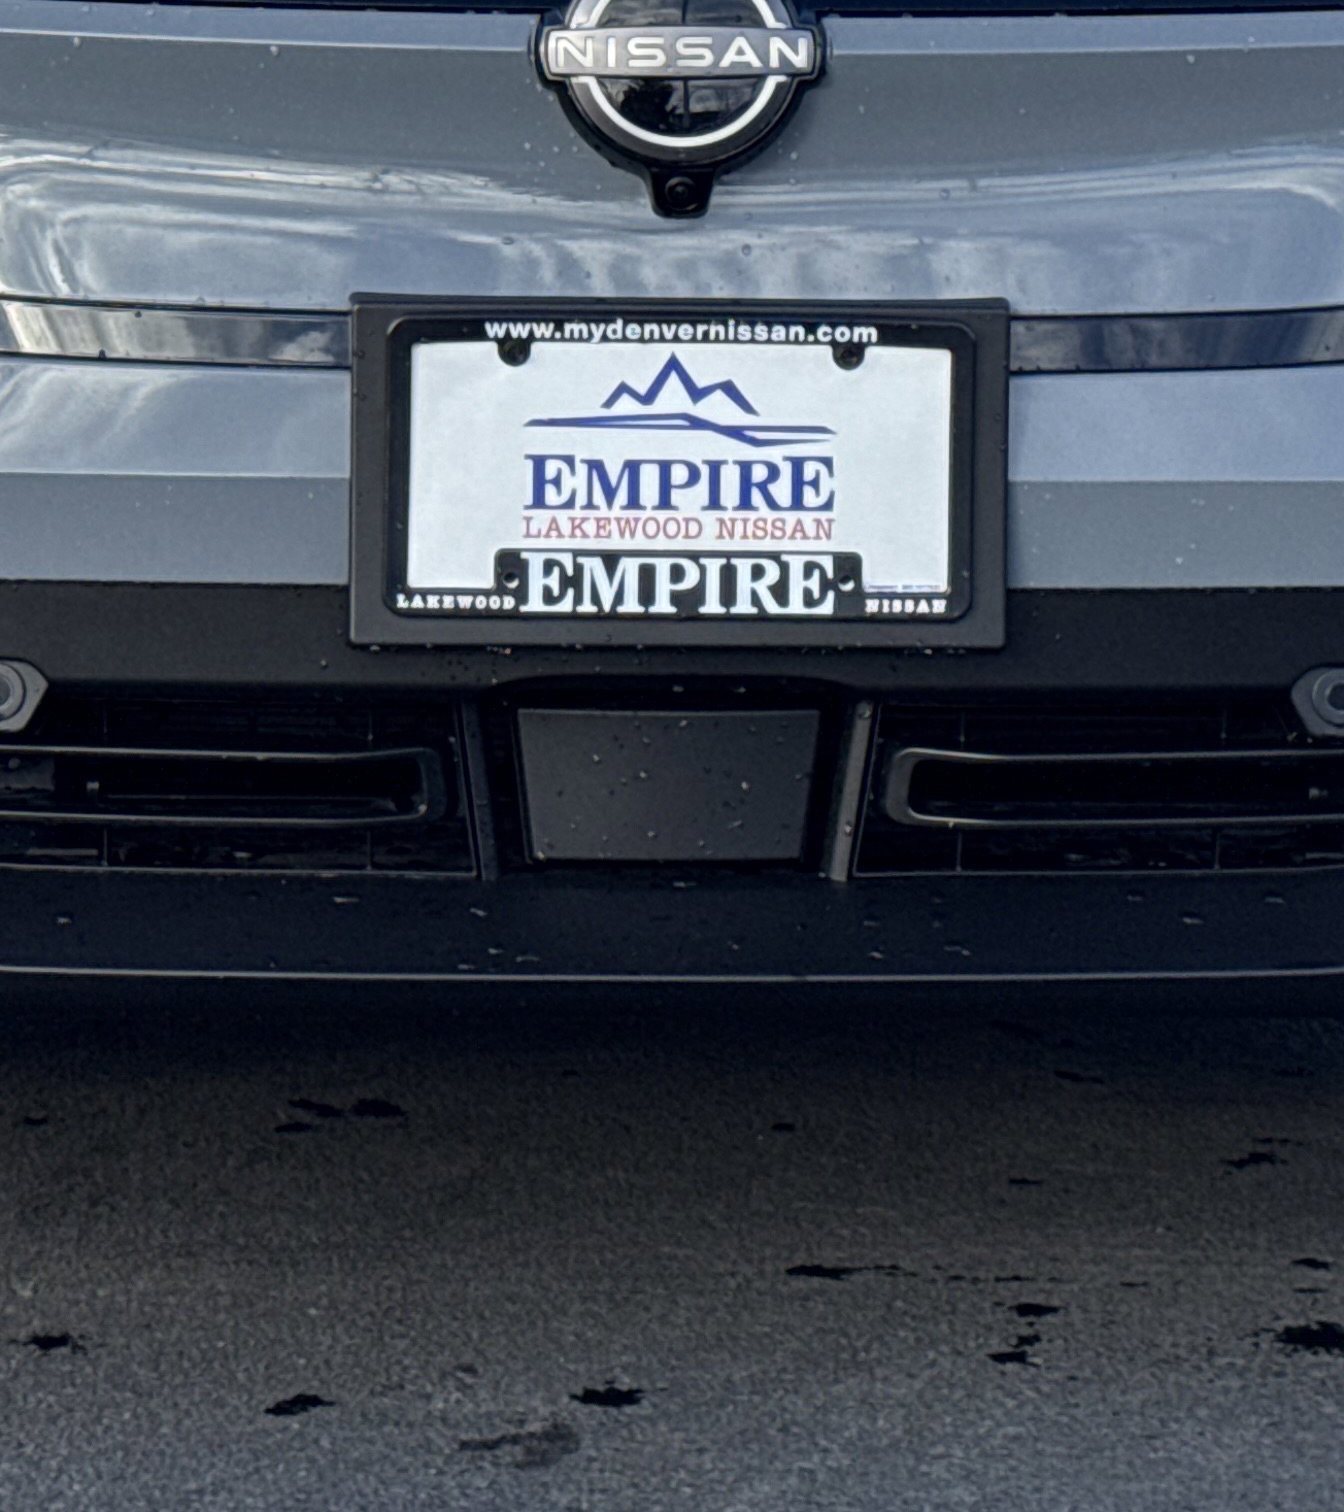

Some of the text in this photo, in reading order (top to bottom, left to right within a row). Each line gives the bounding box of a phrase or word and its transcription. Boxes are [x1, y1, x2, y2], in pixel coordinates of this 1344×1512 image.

[556, 36, 808, 68] NISSAN
[484, 319, 878, 343] www.mydenvernissan.com
[524, 454, 835, 512] EMPIRE
[522, 517, 834, 541] LAKEWOOD NISSAN
[397, 552, 947, 614] LAKEWOOD EMPIRE NISSAN
